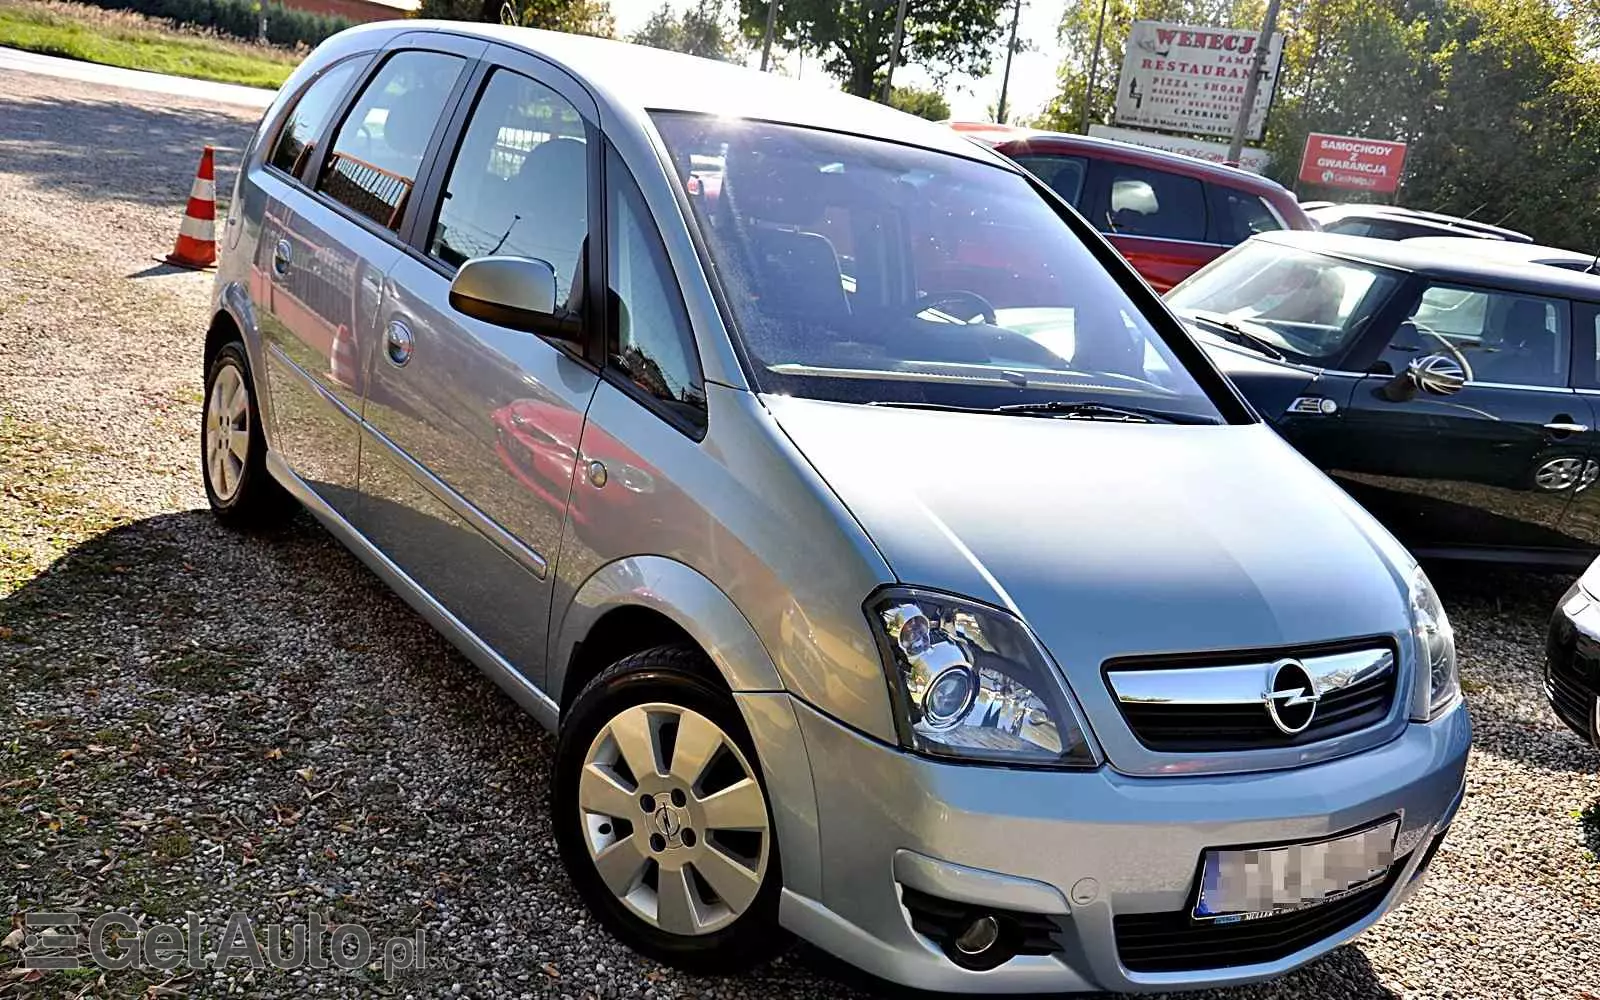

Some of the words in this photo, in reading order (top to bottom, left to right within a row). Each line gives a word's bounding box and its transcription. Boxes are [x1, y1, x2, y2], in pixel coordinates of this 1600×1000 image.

[1156, 28, 1257, 54] WENECJ
[1141, 58, 1251, 80] RESTAURAN
[1152, 77, 1188, 88] PIZZA
[1174, 108, 1229, 120] CATERING
[1321, 140, 1392, 156] SAMOCHODY
[1350, 153, 1359, 161] Z
[1318, 158, 1387, 176] GWARANCJĄ
